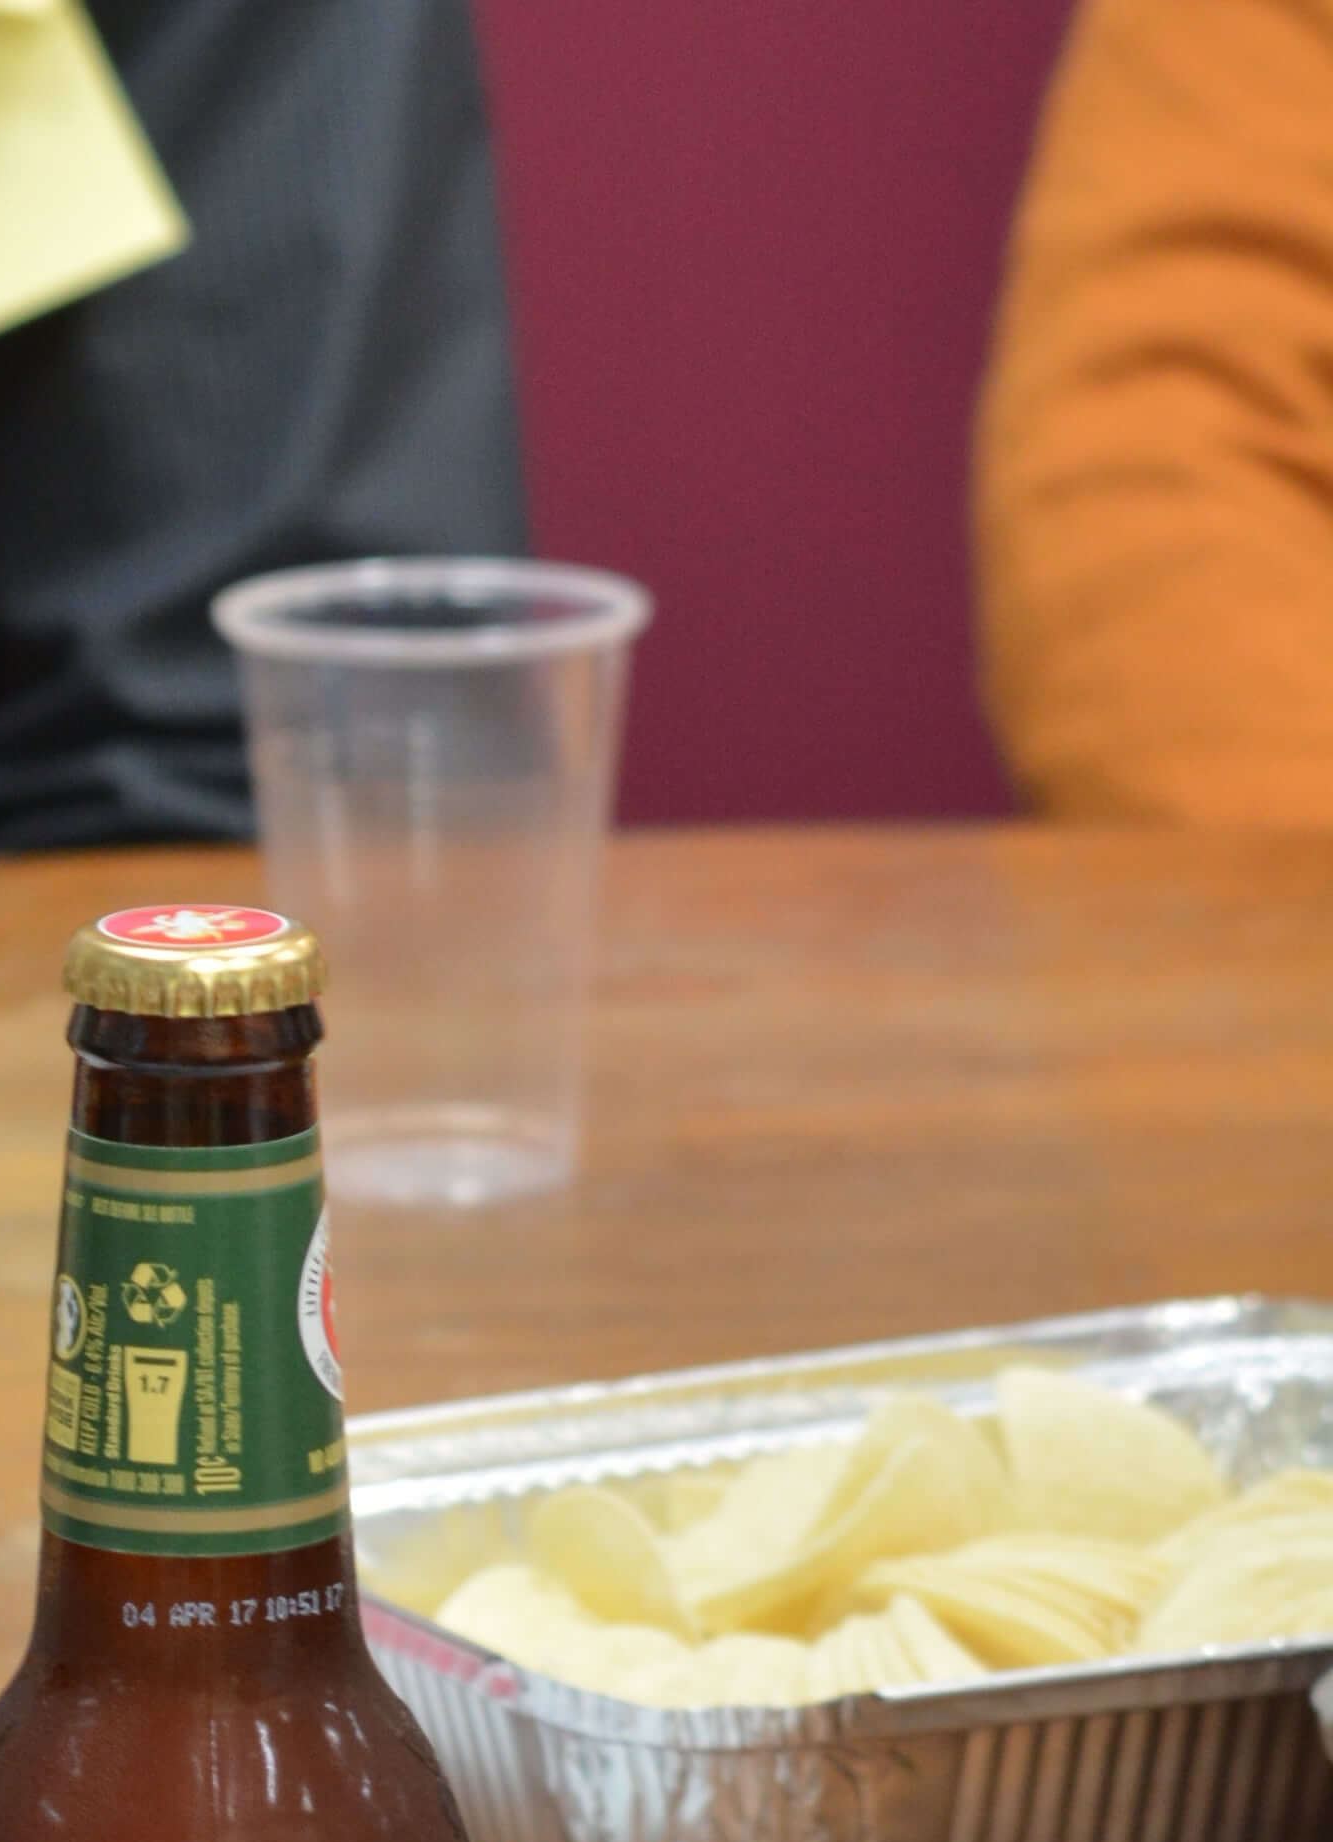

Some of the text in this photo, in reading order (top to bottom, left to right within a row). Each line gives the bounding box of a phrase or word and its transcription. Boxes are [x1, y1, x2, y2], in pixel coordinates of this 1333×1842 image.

[138, 1374, 171, 1396] 1.7
[121, 1601, 156, 1628] 04
[169, 1601, 220, 1628] APR
[229, 1598, 259, 1626] 17
